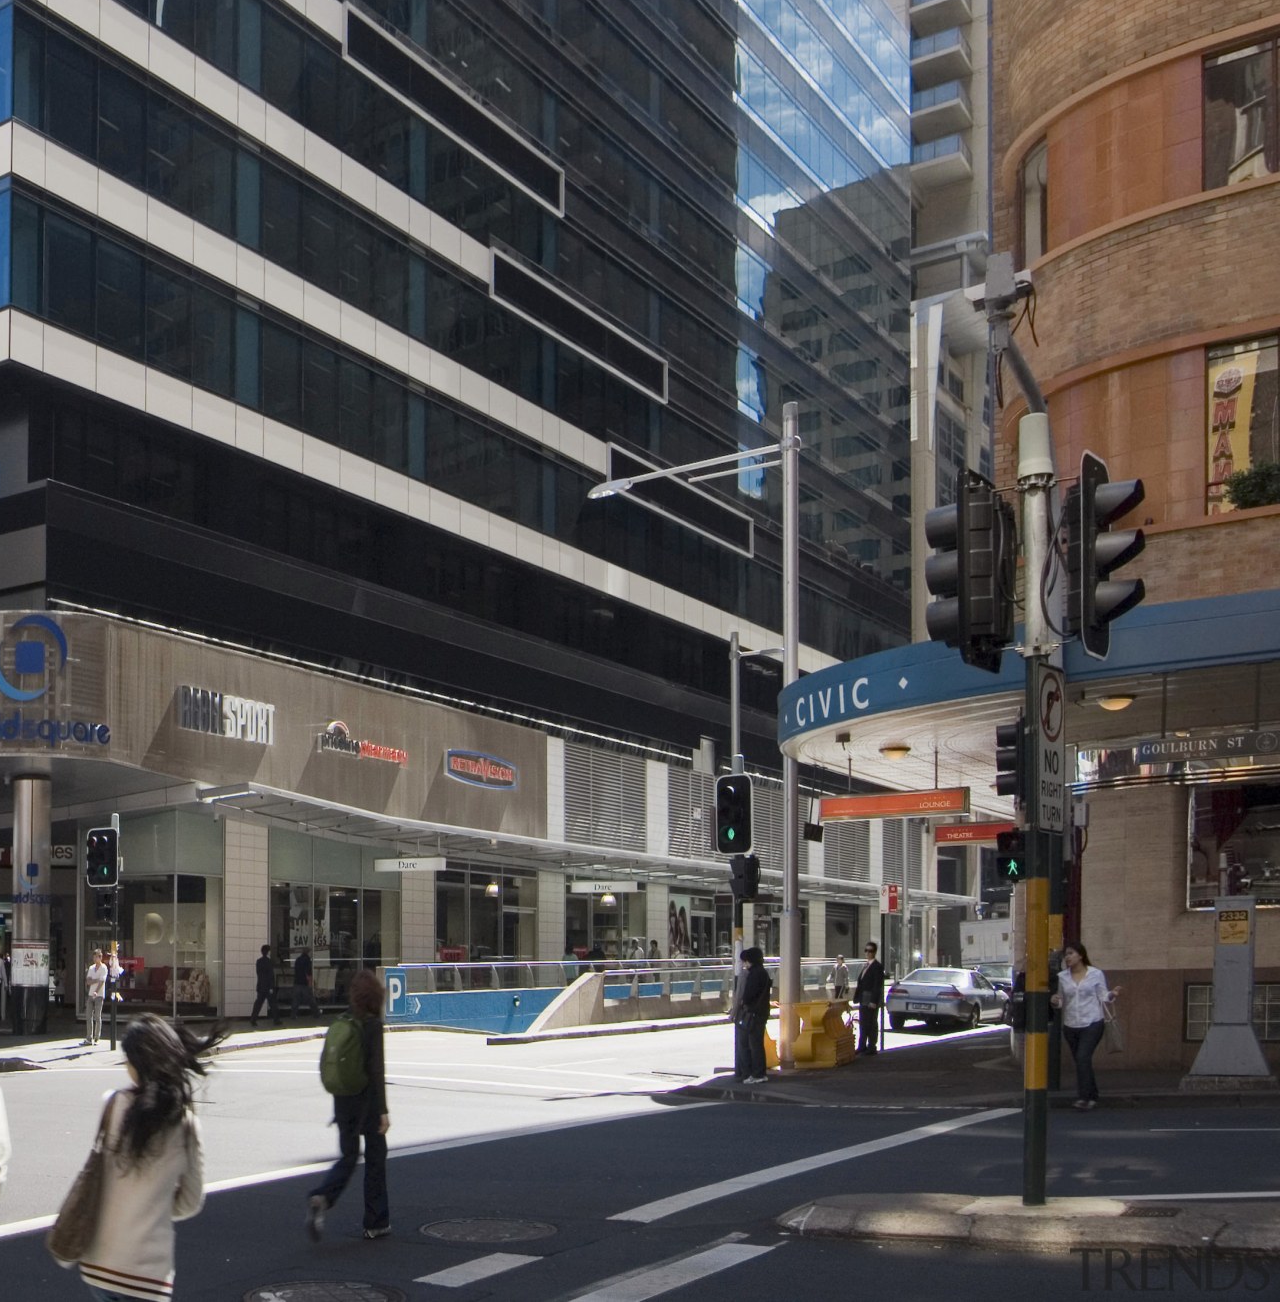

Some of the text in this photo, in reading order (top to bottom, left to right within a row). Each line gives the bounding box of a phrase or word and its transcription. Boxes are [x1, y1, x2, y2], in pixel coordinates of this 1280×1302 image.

[796, 677, 869, 727] CIVIC
[1141, 738, 1219, 756] GOULBURN
[1226, 736, 1245, 750] ST
[1044, 748, 1059, 775] NO
[1041, 780, 1062, 798] RIGHT
[919, 800, 951, 809] LOUNGE
[1041, 804, 1062, 822] TURN
[398, 860, 418, 869] Dare
[594, 883, 612, 891] Dare
[389, 978, 402, 1012] P
